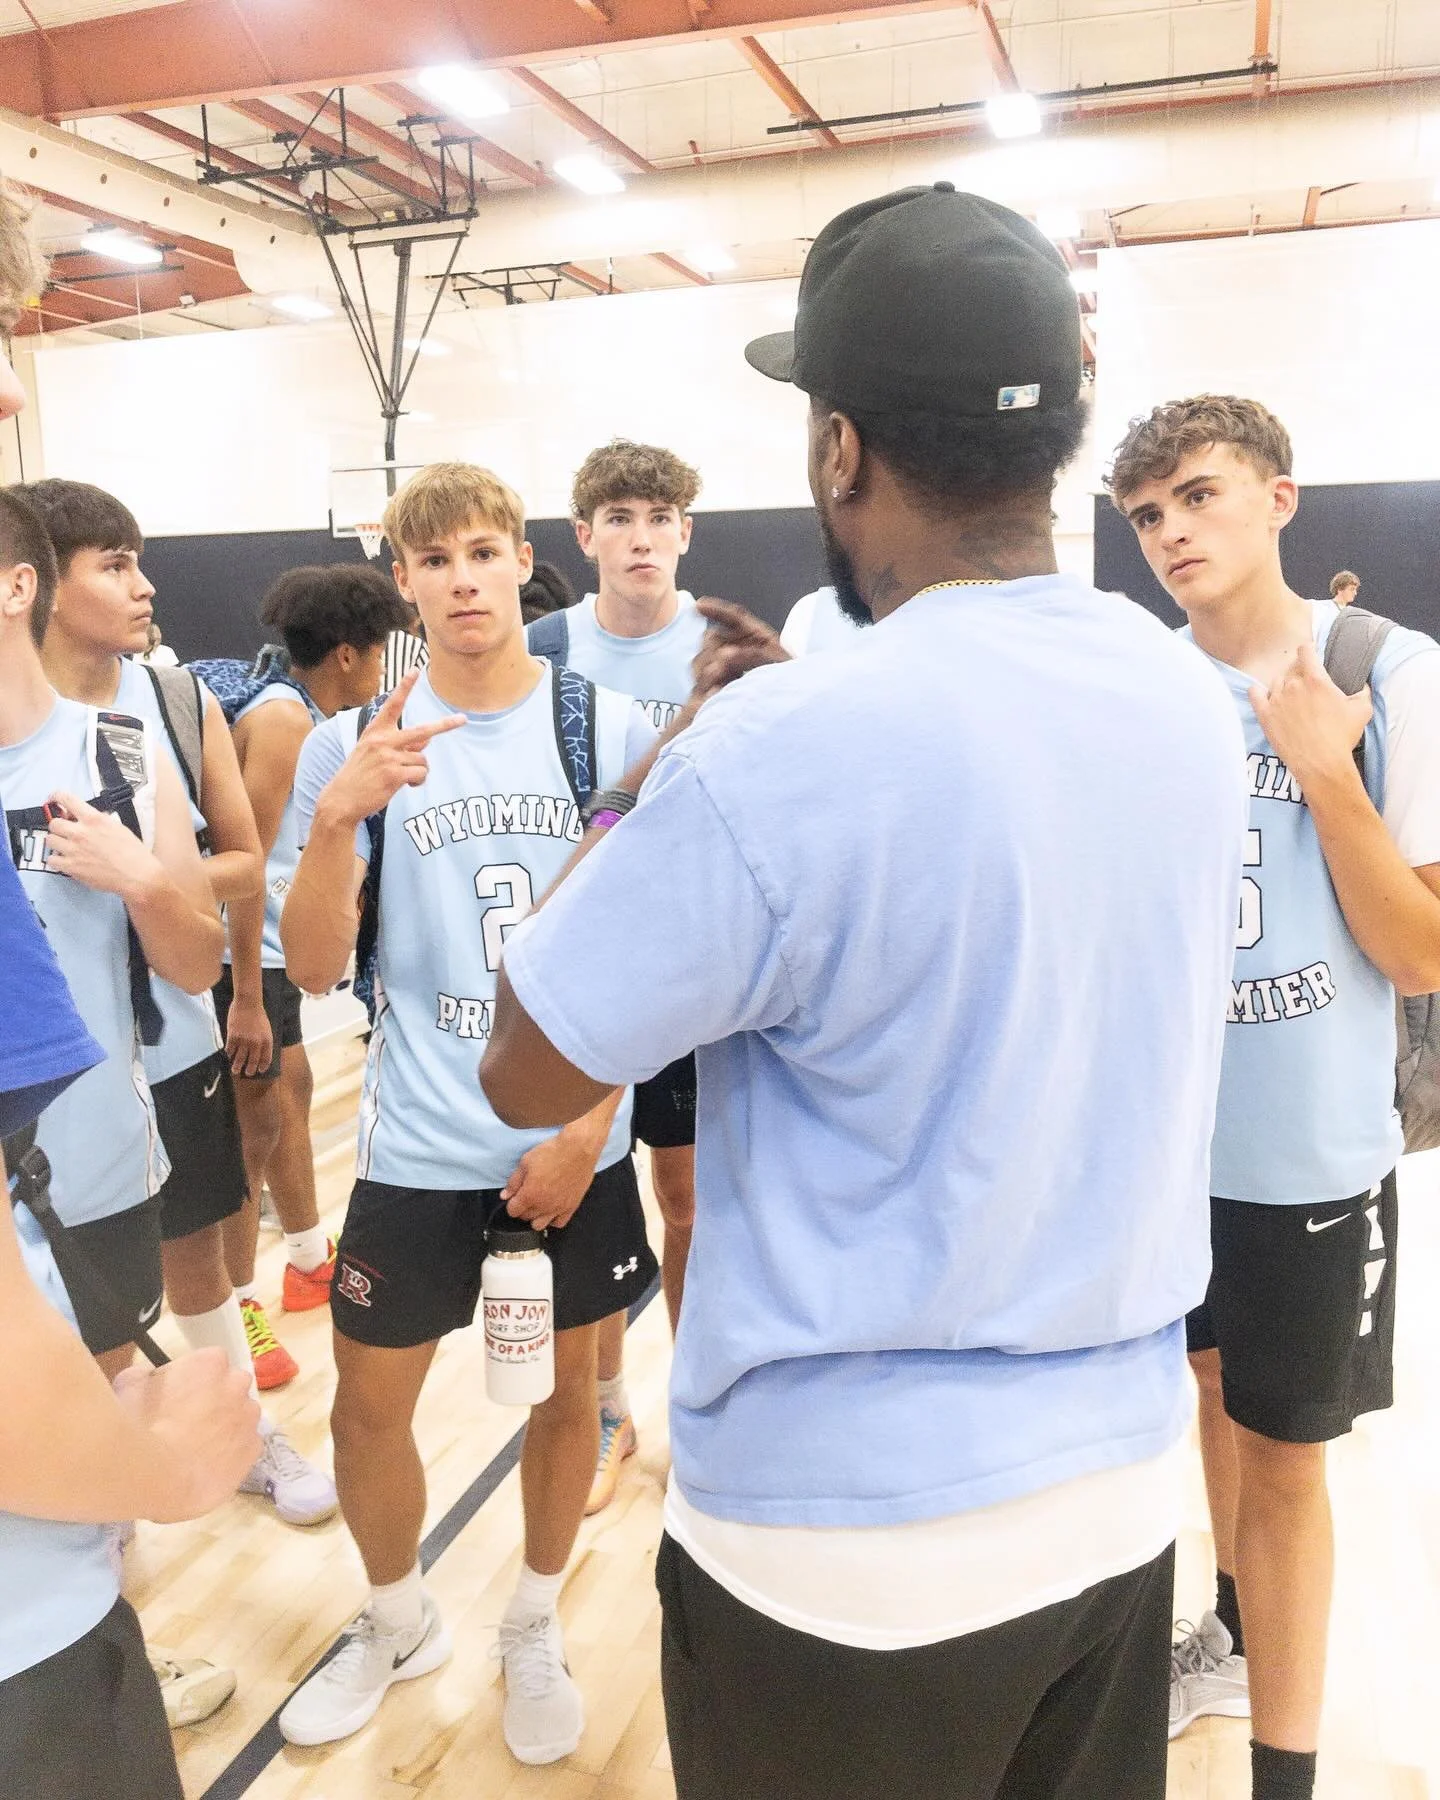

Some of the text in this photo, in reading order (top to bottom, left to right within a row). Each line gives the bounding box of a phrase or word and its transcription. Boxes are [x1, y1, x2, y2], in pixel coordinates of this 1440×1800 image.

[404, 794, 584, 856] WYOMING
[474, 863, 535, 973] 2
[498, 1343, 513, 1355] OF
[517, 1345, 525, 1355] A
